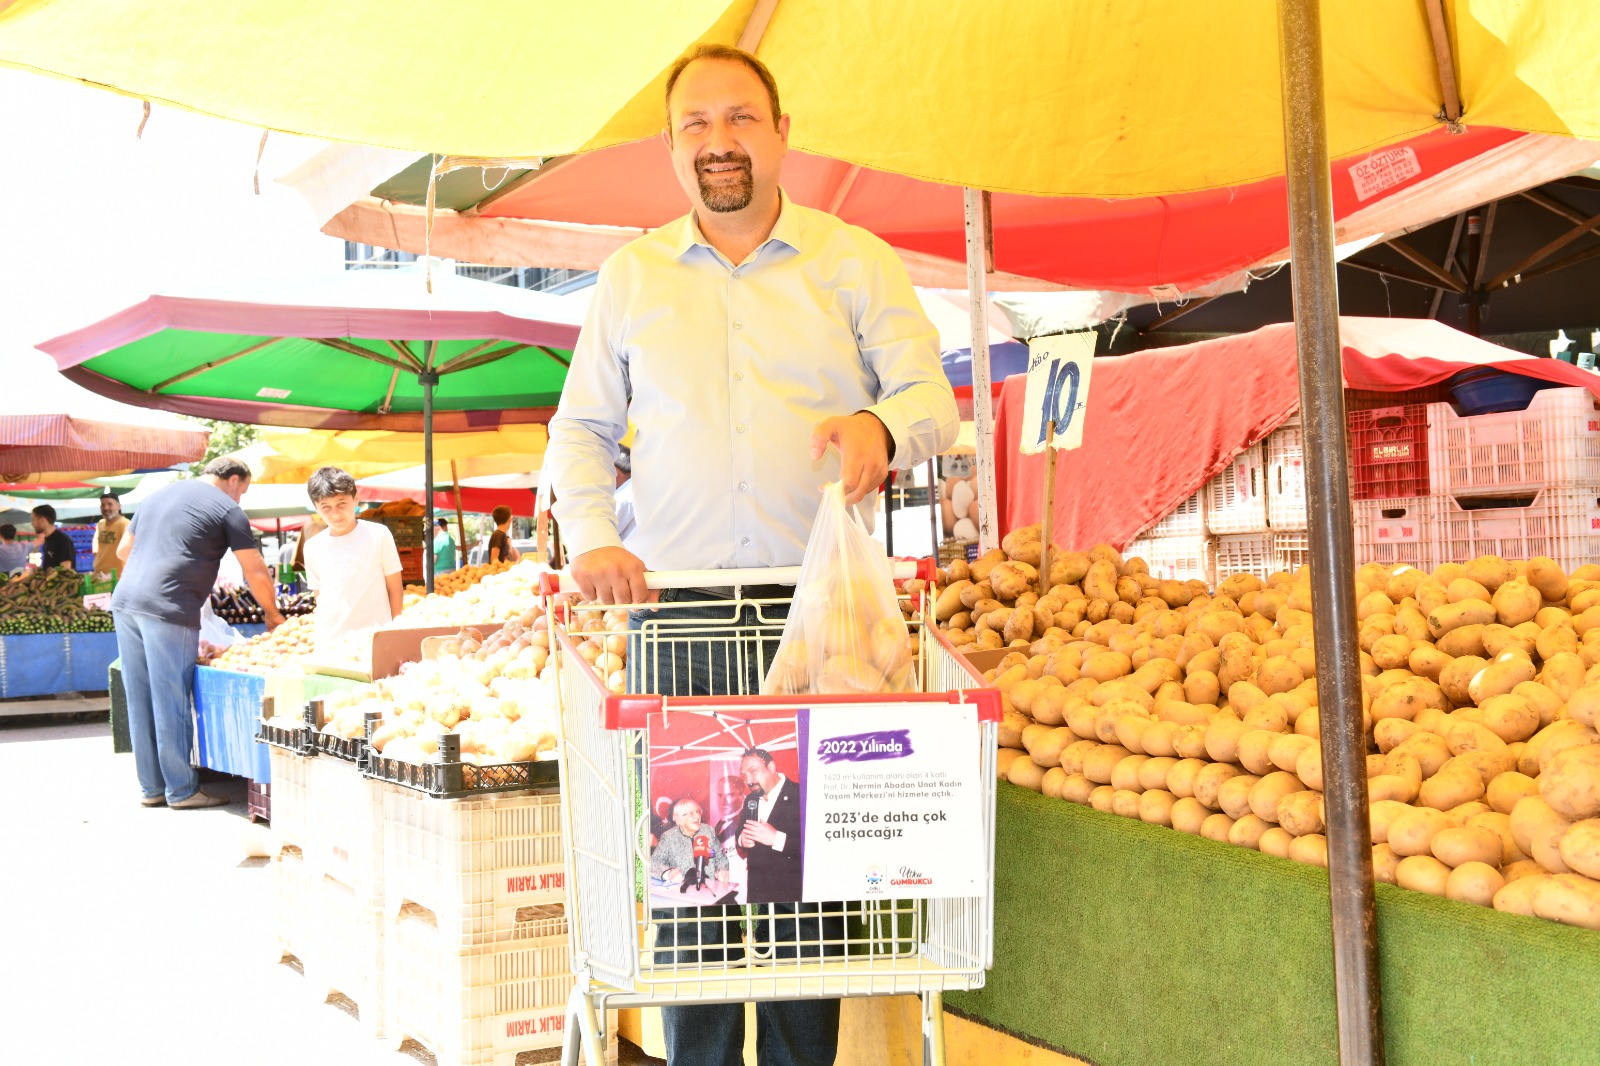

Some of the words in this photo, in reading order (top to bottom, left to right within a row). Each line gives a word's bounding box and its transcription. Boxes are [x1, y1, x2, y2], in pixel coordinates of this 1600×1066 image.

[1037, 358, 1080, 445] 10
[823, 740, 857, 753] 2022
[860, 738, 903, 753] Yılında
[824, 773, 841, 781] 1620
[852, 772, 884, 781] kullanım
[885, 772, 905, 780] alanı
[905, 771, 923, 779] olan
[930, 771, 947, 779] katlı
[852, 781, 882, 789] Nermin
[884, 781, 915, 789] Abadan
[939, 780, 962, 788] Kadın
[824, 792, 851, 801] Yaşam
[853, 791, 895, 799] Merkezi'ni
[931, 790, 954, 799] açtık.
[824, 811, 879, 824] 2023'de
[883, 810, 918, 823] daha
[923, 810, 947, 824] çok
[825, 826, 903, 841] çalışacağız
[899, 866, 923, 879] Utku
[507, 875, 537, 893] TARIM
[540, 872, 565, 892] İRLİK
[506, 1018, 537, 1038] TARIM
[539, 1014, 566, 1036] İRLİK
